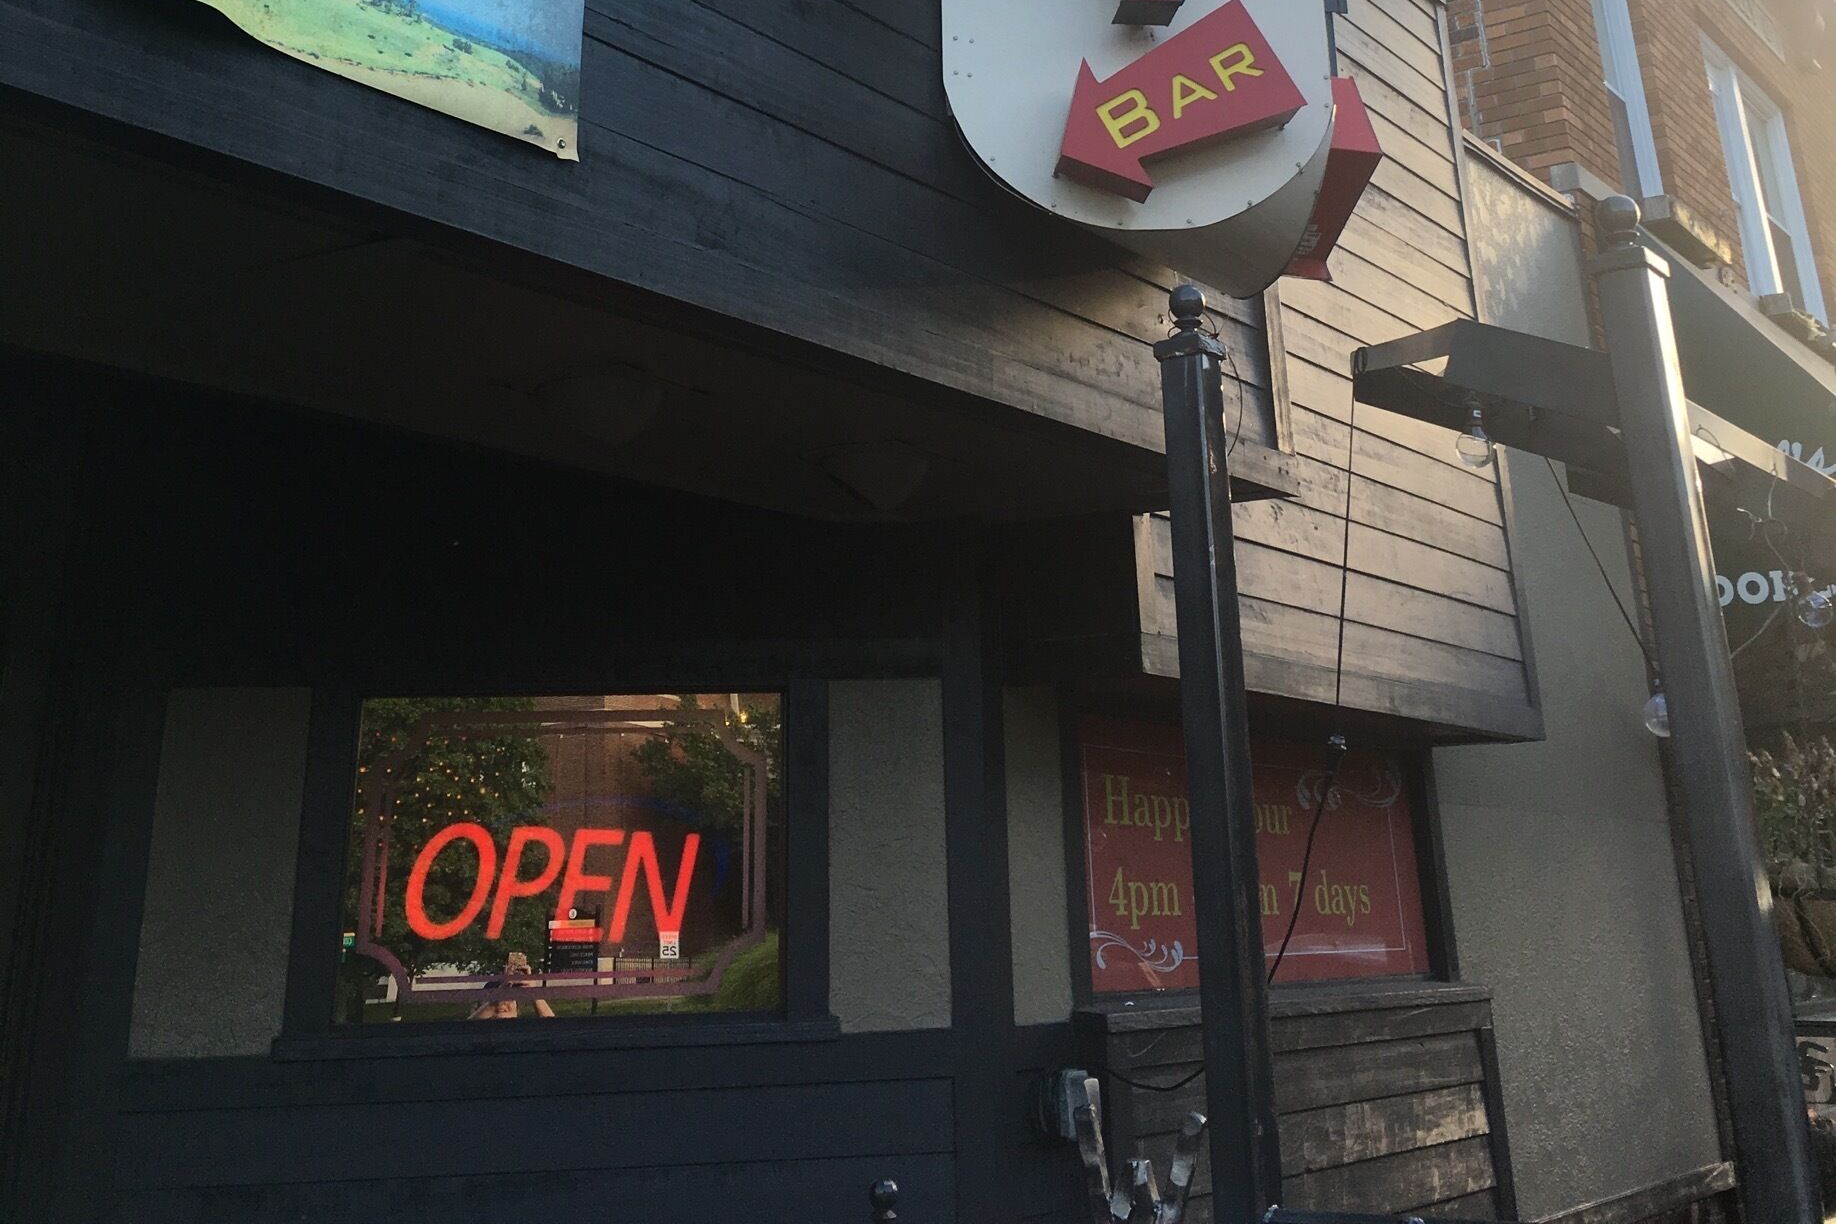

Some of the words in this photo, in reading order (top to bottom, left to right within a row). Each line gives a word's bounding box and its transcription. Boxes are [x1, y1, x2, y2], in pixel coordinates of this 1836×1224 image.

[1096, 41, 1265, 150] BAR
[1104, 775, 1190, 842] Happ
[404, 821, 701, 943] OPEN
[1108, 866, 1183, 930] 4pm
[1314, 869, 1371, 927] days
